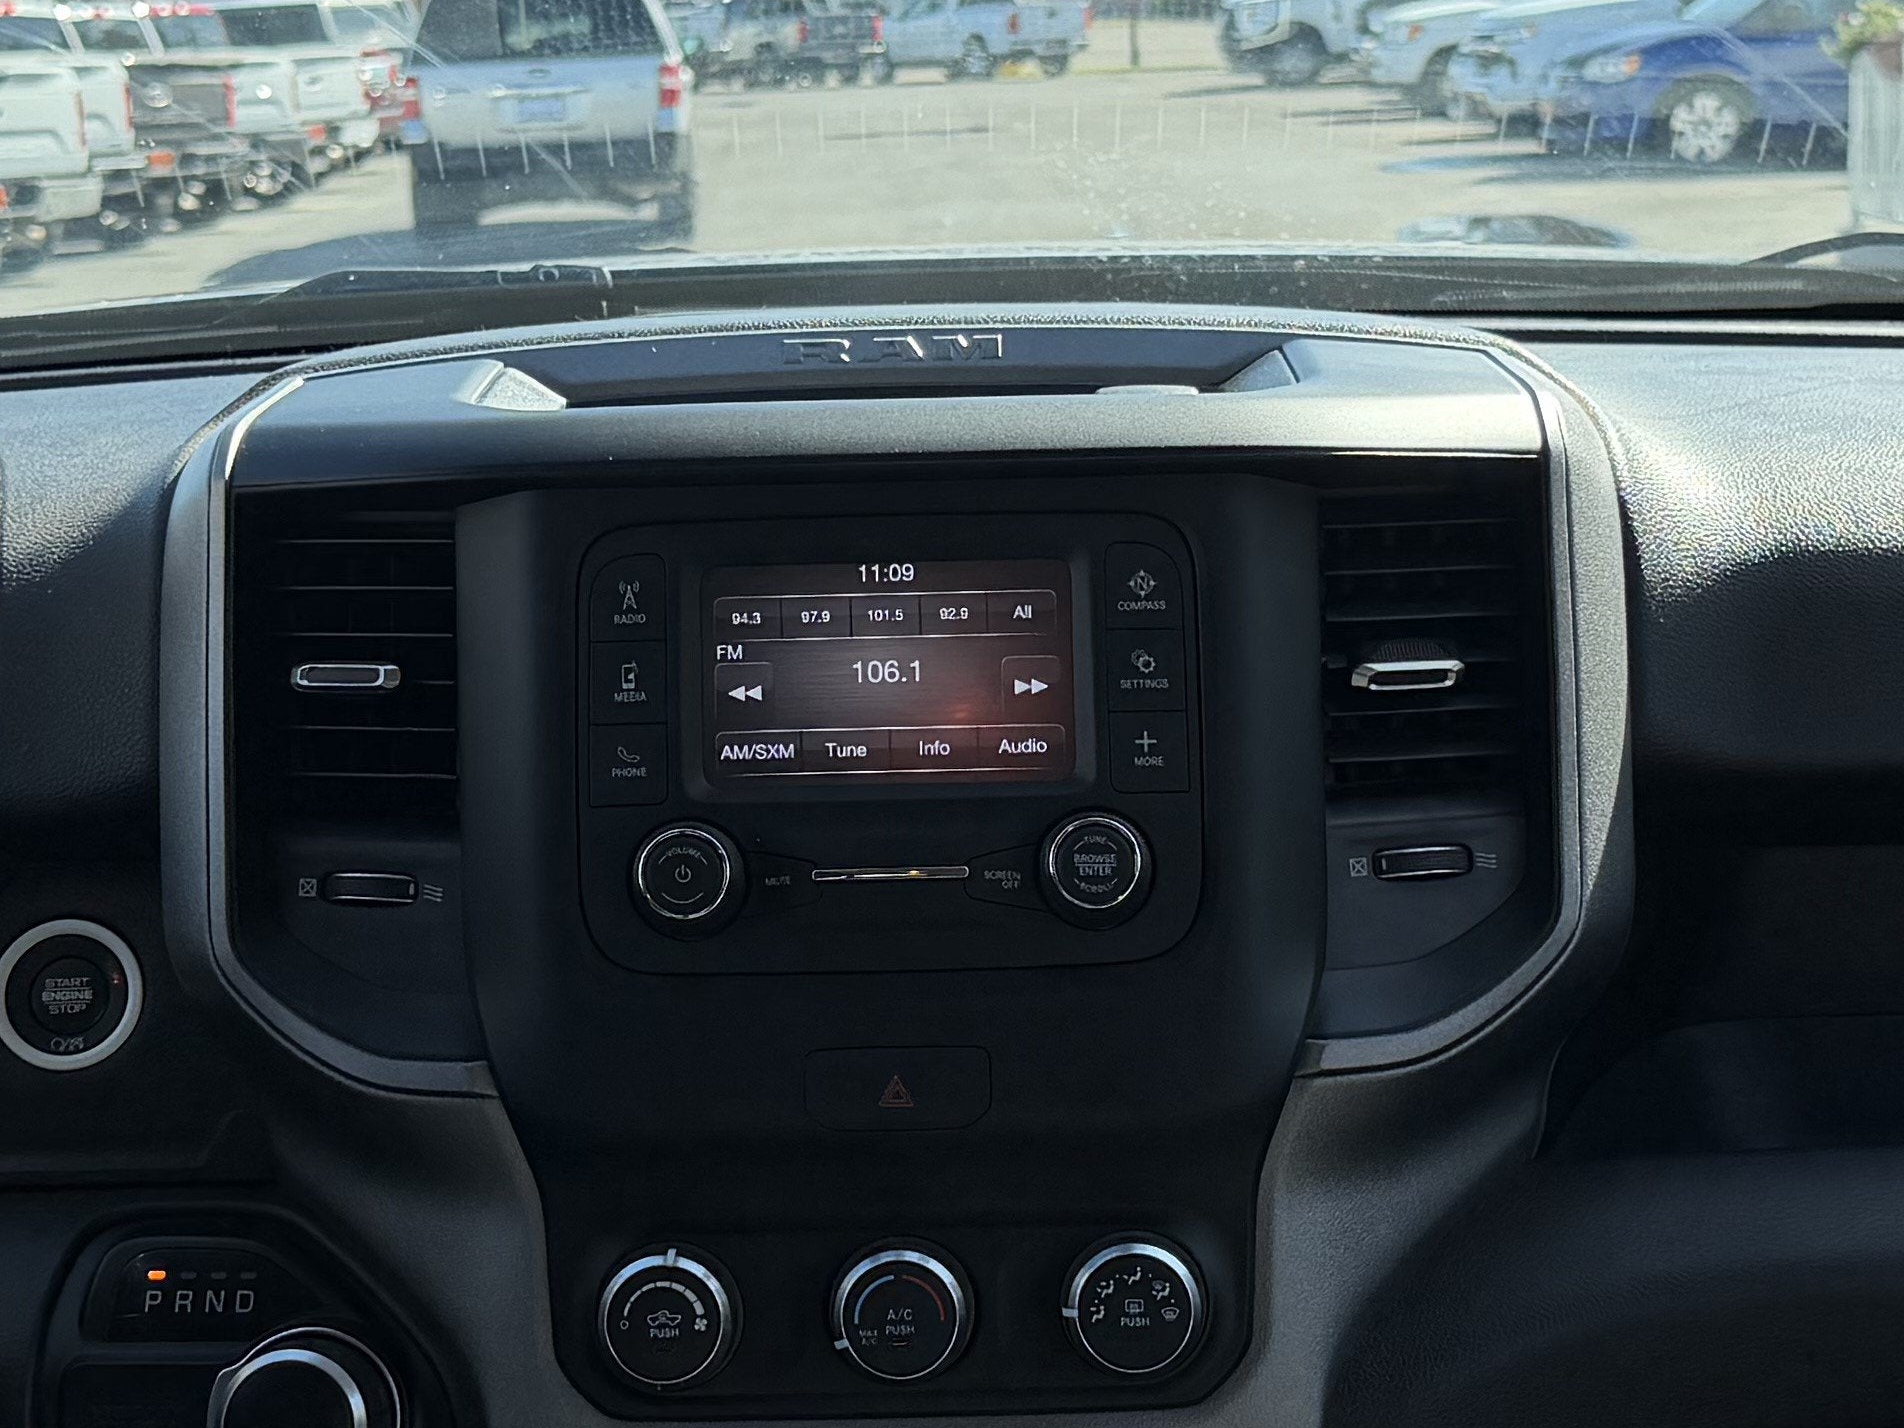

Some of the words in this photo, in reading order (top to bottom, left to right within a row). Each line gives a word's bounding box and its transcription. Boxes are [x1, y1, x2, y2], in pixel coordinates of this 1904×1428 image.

[782, 333, 1003, 365] RAM
[858, 563, 915, 583] 11:09
[1117, 600, 1166, 611] COMPASS
[800, 610, 831, 623] 97.9
[867, 608, 904, 622] 101.5
[1013, 605, 1033, 619] All
[613, 613, 647, 625] RADIO
[731, 612, 762, 625] 94.3
[716, 645, 744, 661] FM
[852, 659, 921, 684] 106.1
[1119, 678, 1169, 689] SETTINGS
[614, 691, 647, 703] MEDIA
[719, 744, 796, 761] AM/SXM
[824, 742, 868, 759] Tune
[919, 740, 951, 756] Info
[998, 738, 1048, 755] Audio
[1134, 756, 1165, 767] MORE
[611, 767, 648, 779] PHONE
[1073, 853, 1116, 864] BROWSE
[983, 870, 1022, 881] SCREEN
[1079, 866, 1113, 877] ENTER
[44, 977, 92, 988] START
[41, 990, 93, 1002] ENGINE
[48, 1003, 87, 1015] STOP
[144, 1290, 162, 1313] P
[174, 1290, 193, 1313] R
[204, 1289, 225, 1313] N
[235, 1289, 254, 1313] D
[886, 1307, 913, 1321] A/C
[1120, 1316, 1151, 1327] PUSH
[649, 1327, 680, 1339] PUSH
[885, 1325, 916, 1336] PUSH
